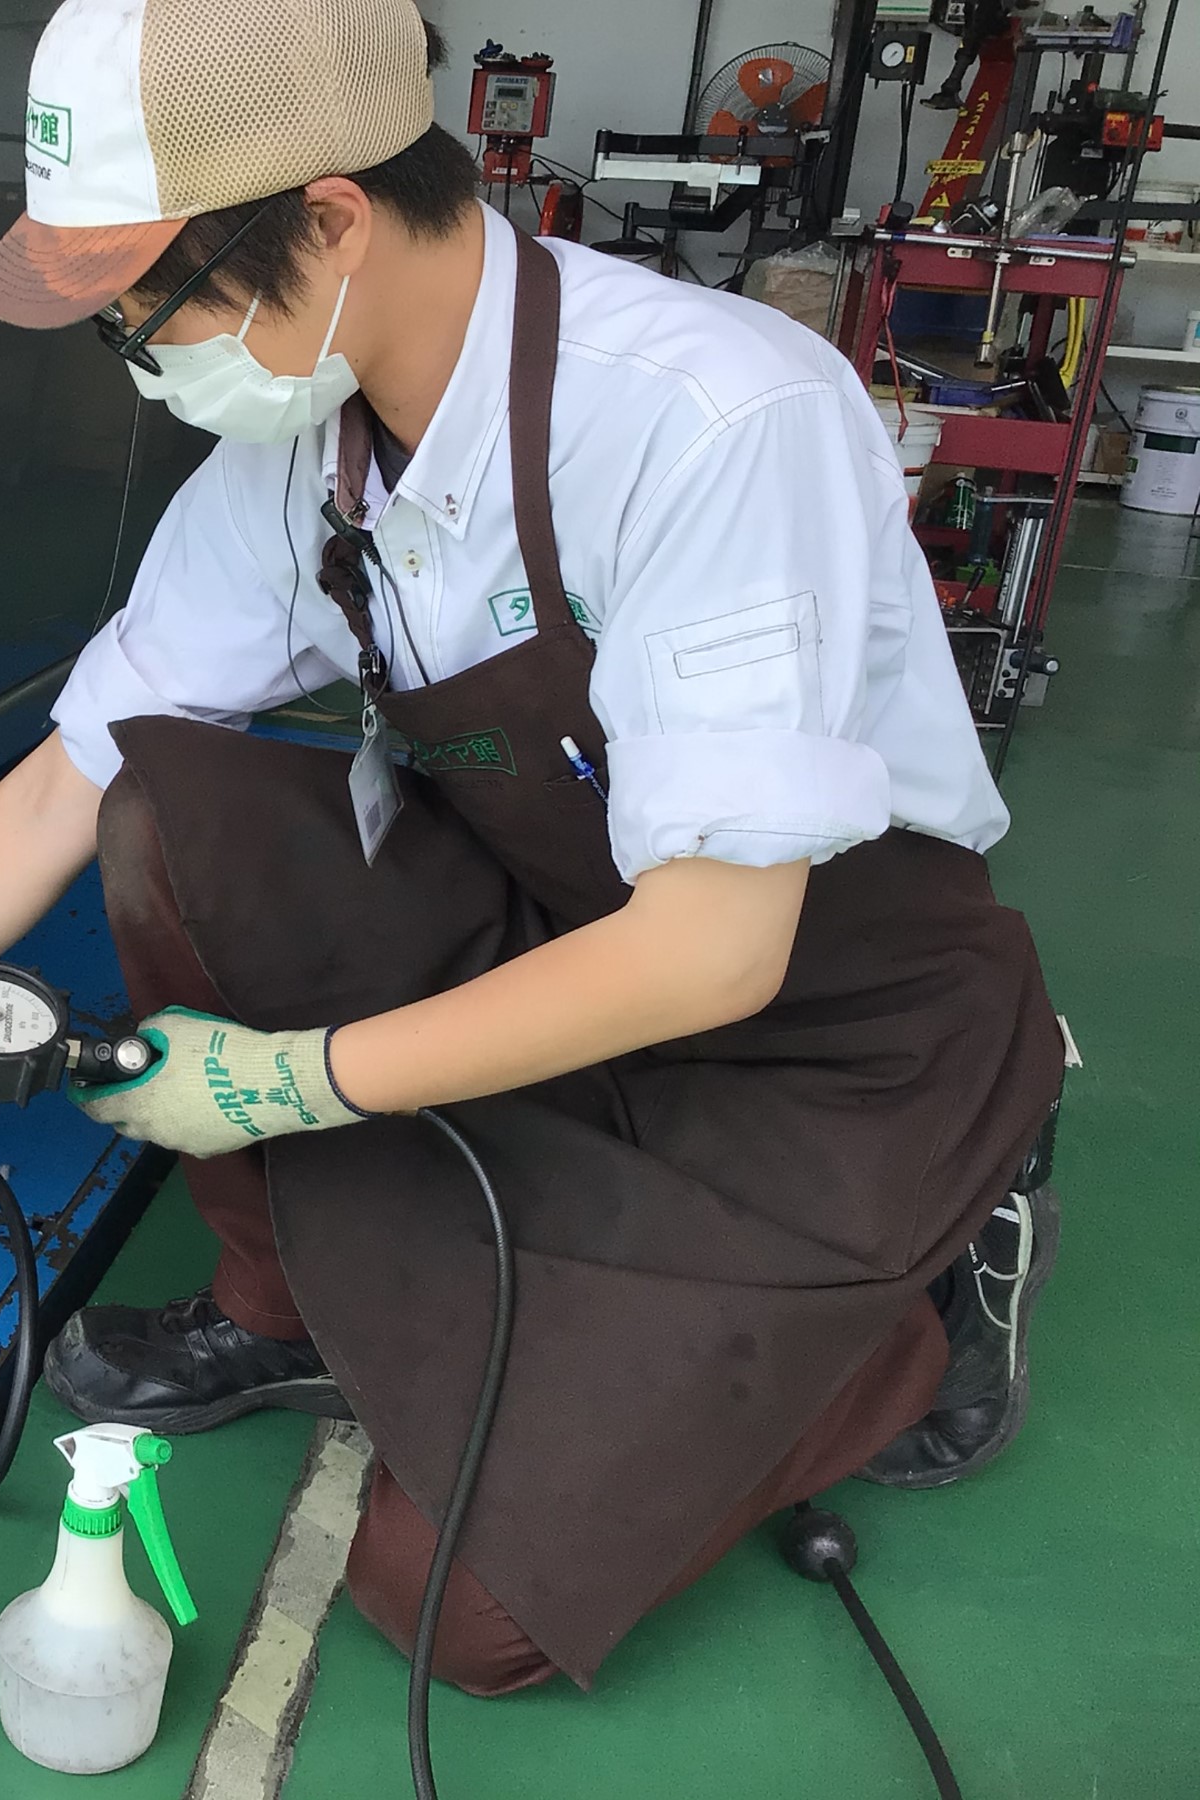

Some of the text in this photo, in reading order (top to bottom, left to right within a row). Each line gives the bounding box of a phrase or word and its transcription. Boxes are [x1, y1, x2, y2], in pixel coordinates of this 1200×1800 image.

[203, 1055, 253, 1125] GRIP
[239, 1088, 263, 1105] M
[275, 1051, 320, 1126] SHOWA
